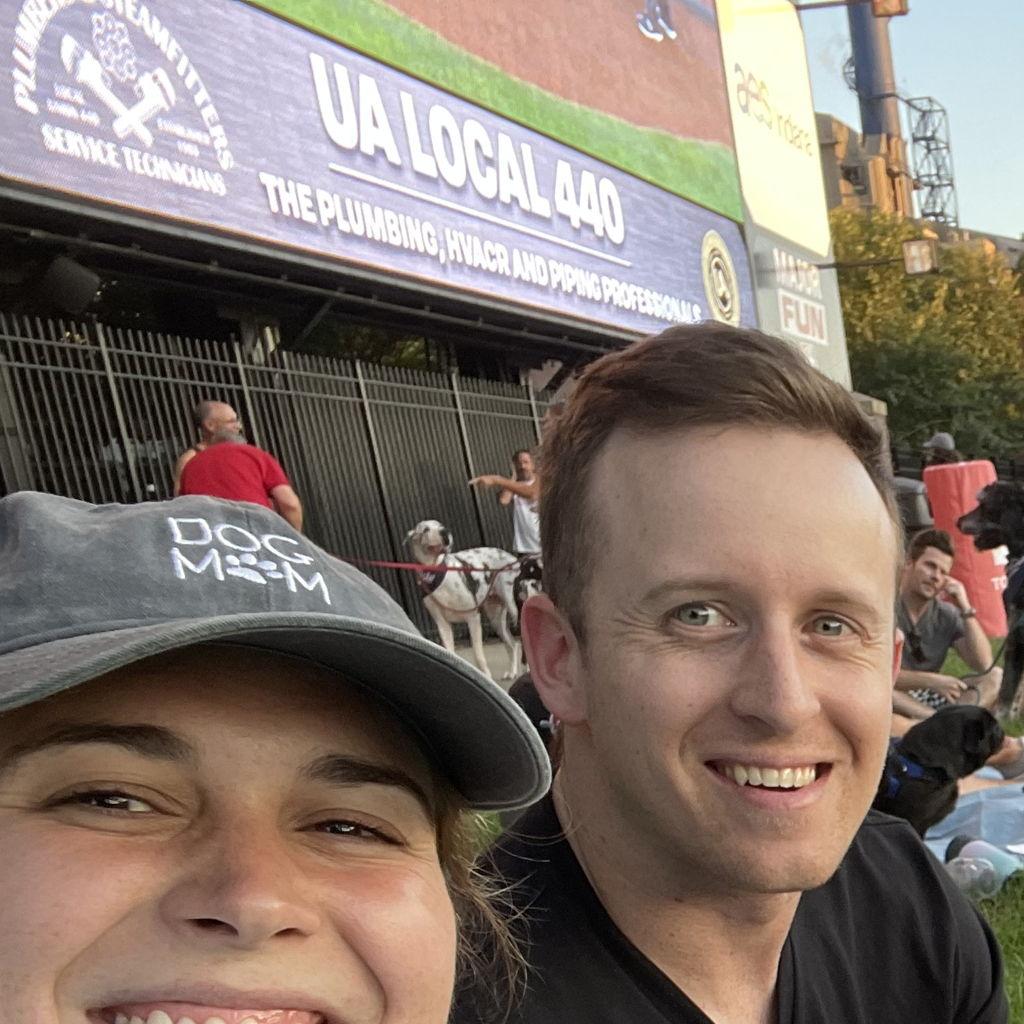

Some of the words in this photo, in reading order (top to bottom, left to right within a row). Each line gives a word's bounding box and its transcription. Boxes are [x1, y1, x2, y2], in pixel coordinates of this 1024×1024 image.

[41, 122, 122, 169] SERVICE
[121, 146, 227, 197] TECHNICIANS
[309, 52, 402, 165] UA
[400, 90, 552, 219] LOCAL
[554, 159, 626, 245] 440
[258, 171, 318, 224] THE
[315, 188, 446, 264] PLUMBING,
[444, 226, 512, 275] HVACR
[512, 248, 550, 287] AND
[549, 260, 602, 301] PIPING
[781, 294, 826, 340] FUN
[168, 517, 314, 565] DOG
